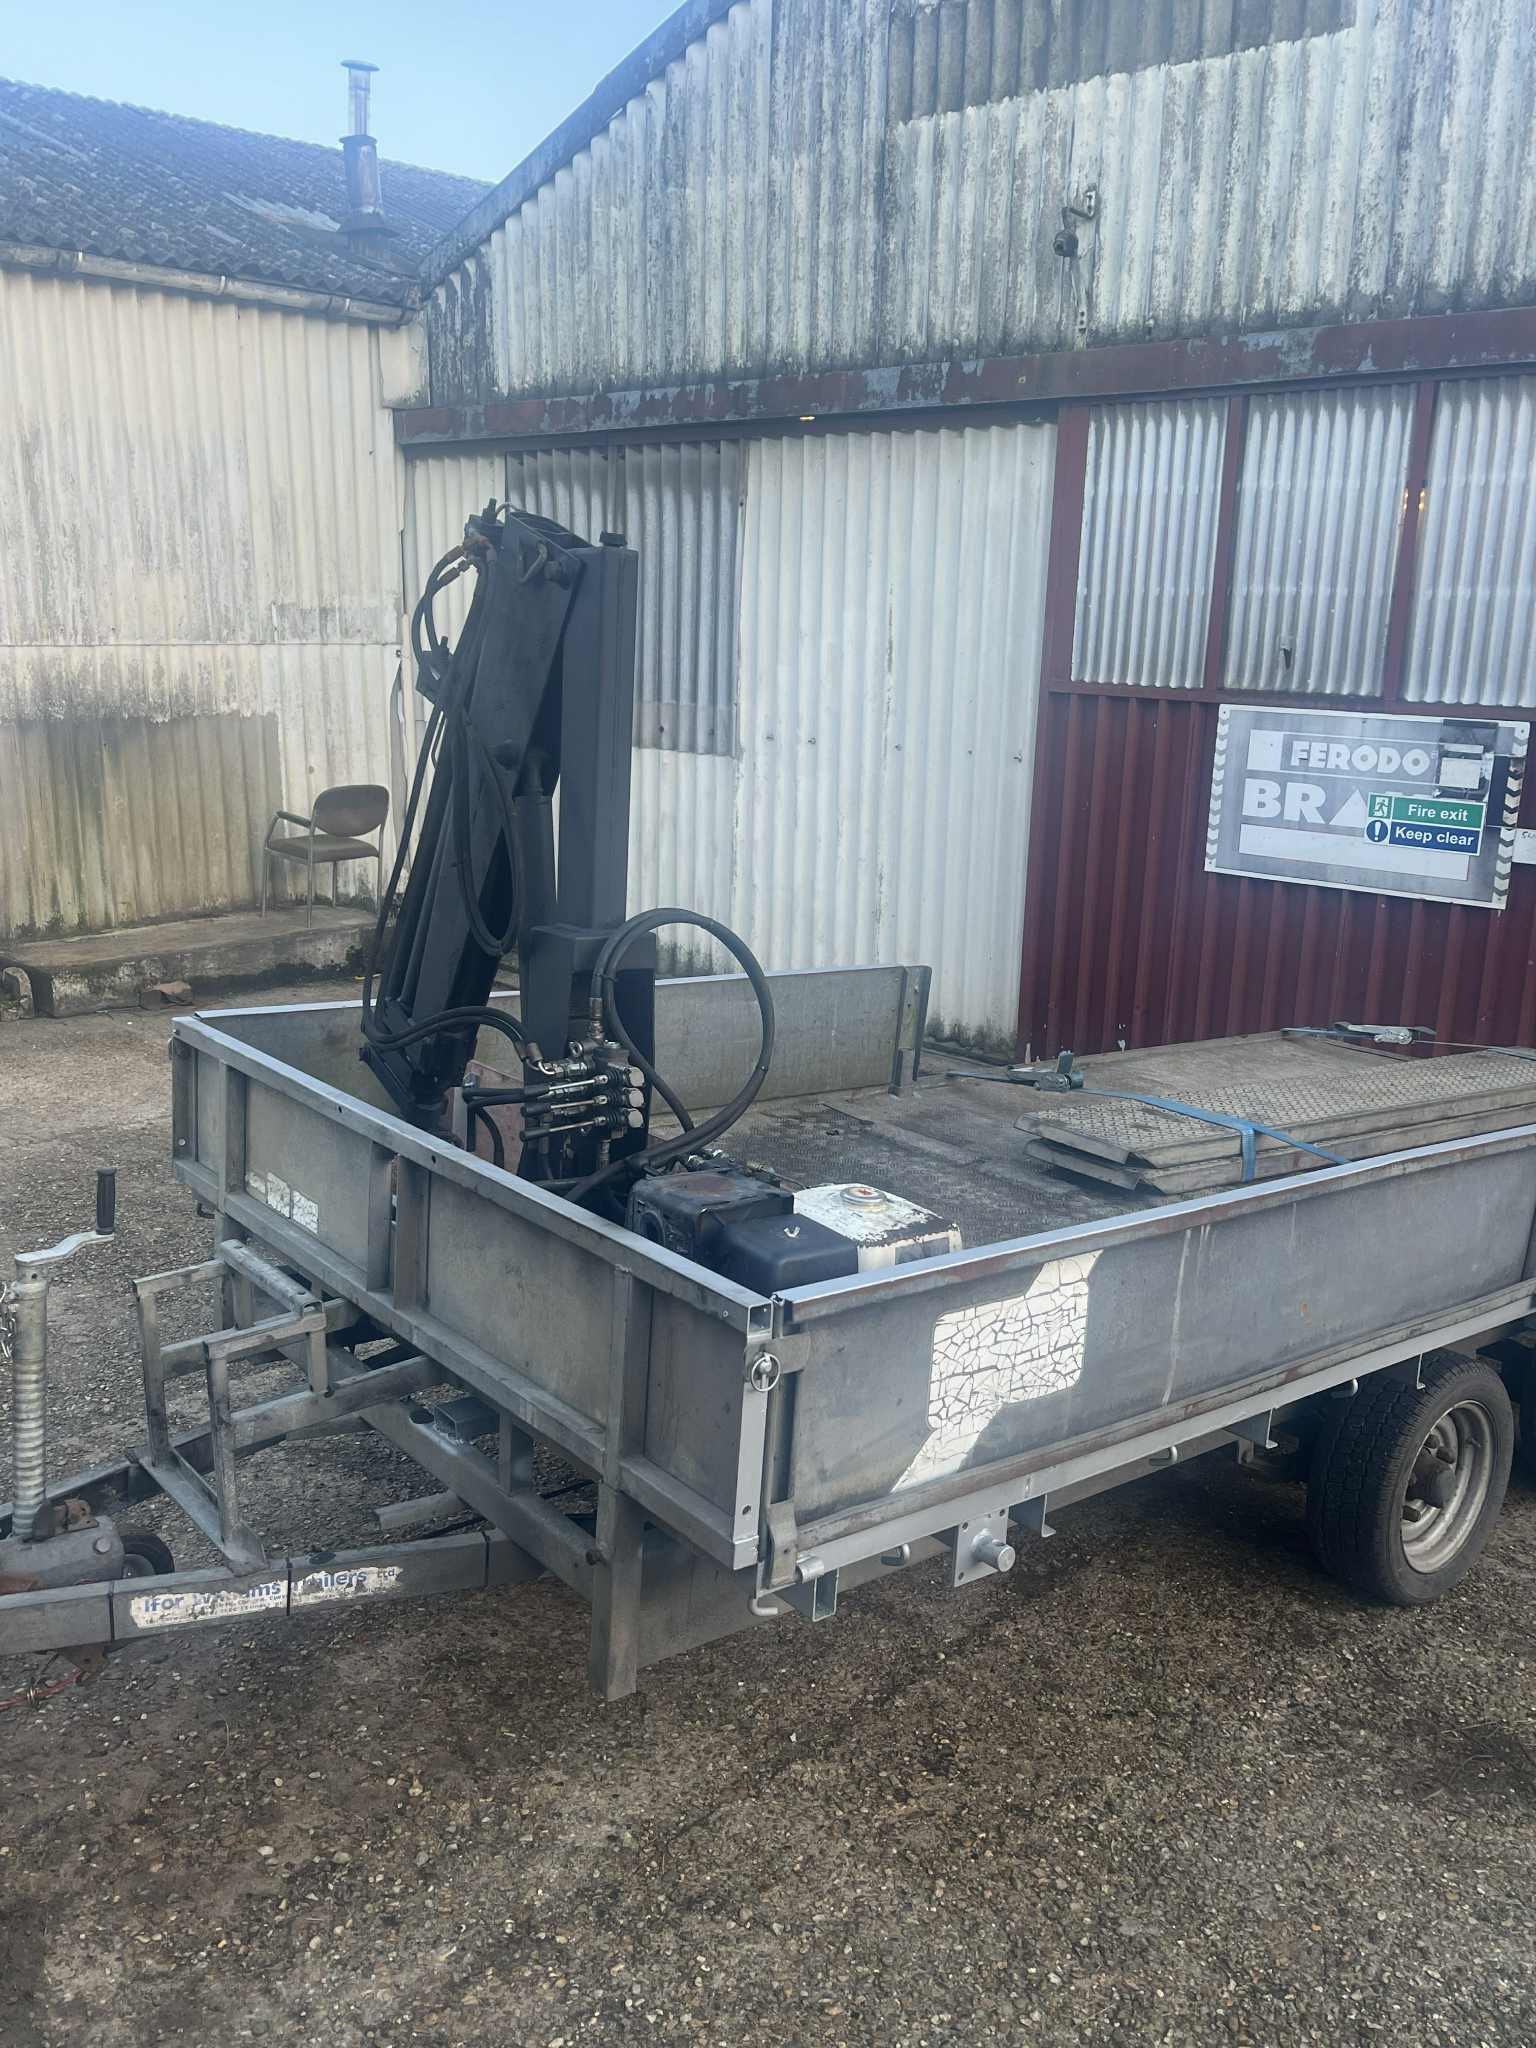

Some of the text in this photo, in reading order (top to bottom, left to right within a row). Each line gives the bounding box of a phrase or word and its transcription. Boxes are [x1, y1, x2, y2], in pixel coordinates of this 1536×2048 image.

[1290, 740, 1430, 776] FERODO
[1408, 804, 1468, 822] Fire exit
[1395, 826, 1474, 846] Keep clear
